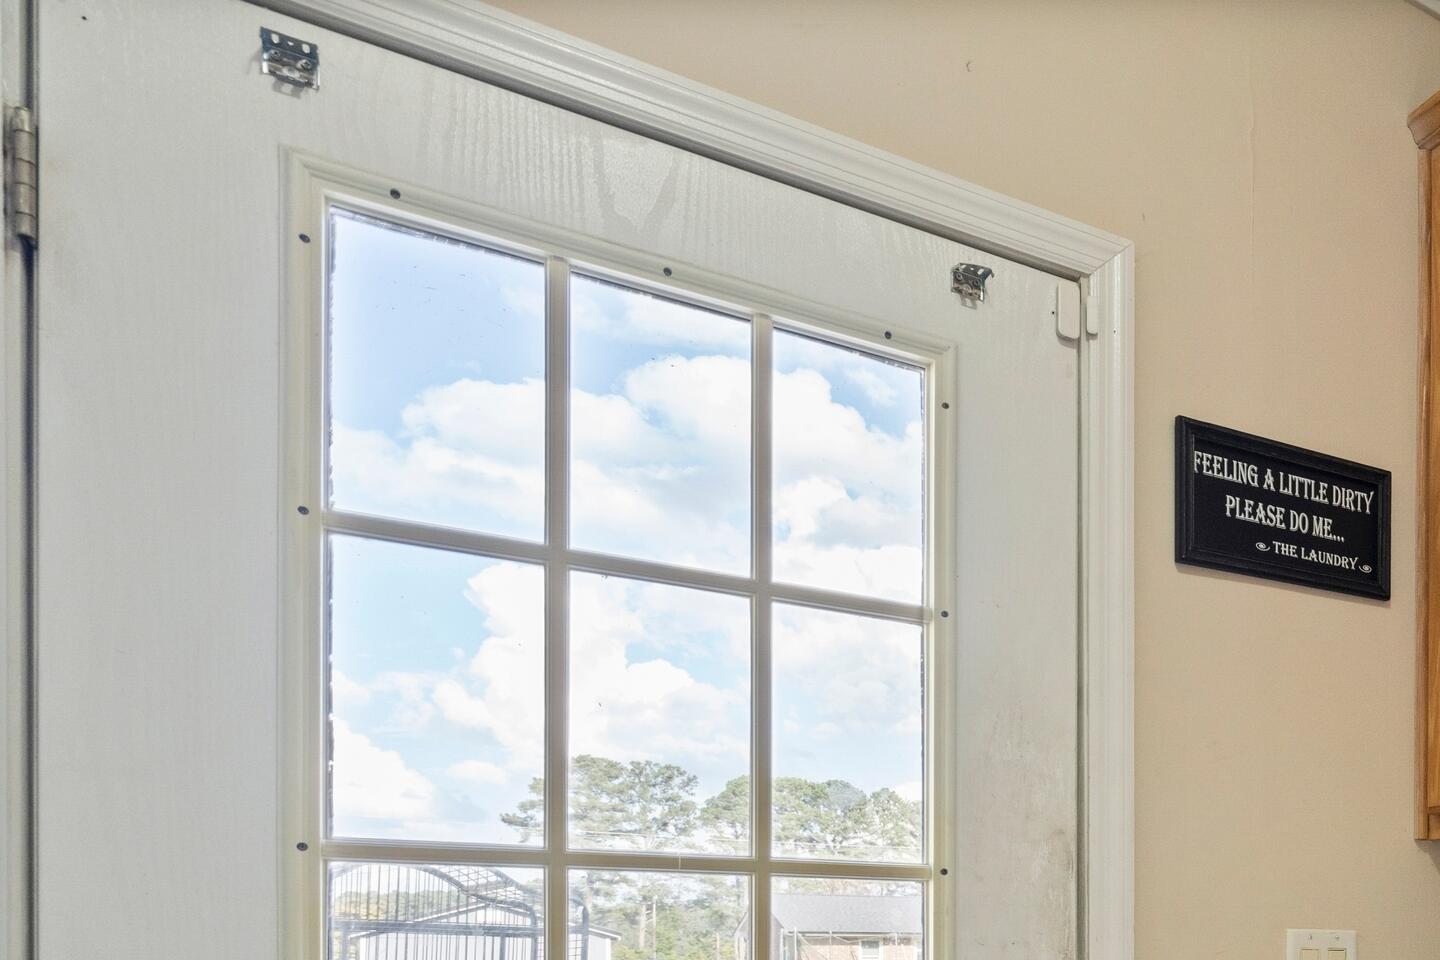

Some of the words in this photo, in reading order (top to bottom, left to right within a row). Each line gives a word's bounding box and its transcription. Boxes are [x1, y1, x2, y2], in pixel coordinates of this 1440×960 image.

[1194, 450, 1259, 488] FEELING
[1263, 468, 1276, 492] A
[1279, 471, 1329, 505] LITTLE
[1332, 485, 1375, 515] DIRTY
[1225, 494, 1287, 530] PLEASE
[1289, 509, 1309, 534] DO
[1272, 541, 1299, 558] THE
[1301, 547, 1359, 570] LAUNDRY
